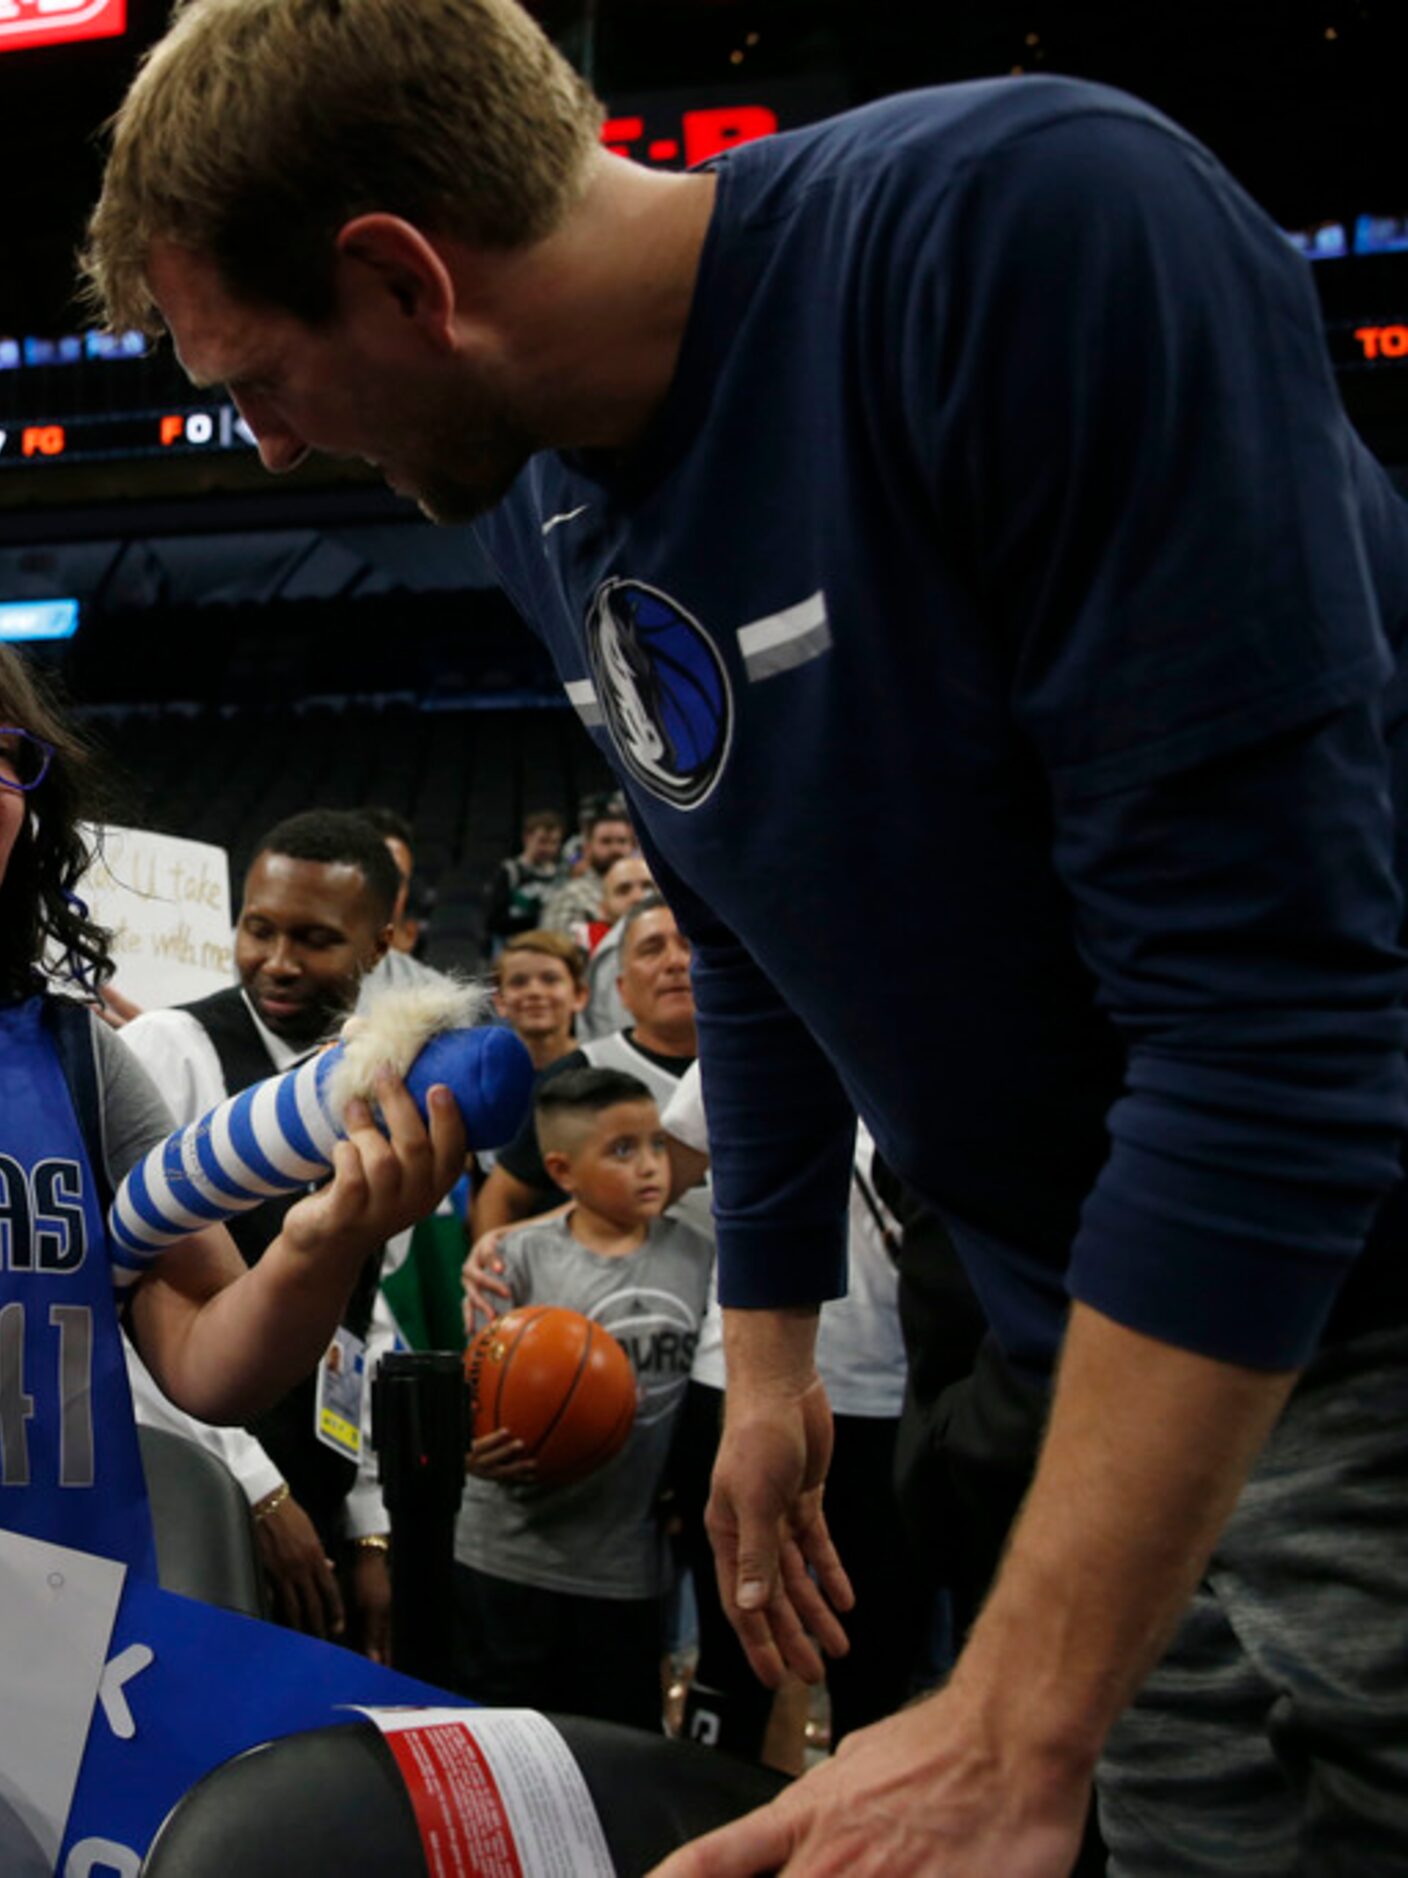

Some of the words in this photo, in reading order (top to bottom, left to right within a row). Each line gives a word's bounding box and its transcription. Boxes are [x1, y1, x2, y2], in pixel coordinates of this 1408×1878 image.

[22, 425, 65, 457] FG
[159, 414, 184, 446] F
[169, 862, 224, 911] take
[151, 919, 198, 966] with
[200, 938, 234, 975] me
[618, 1331, 699, 1373] URS
